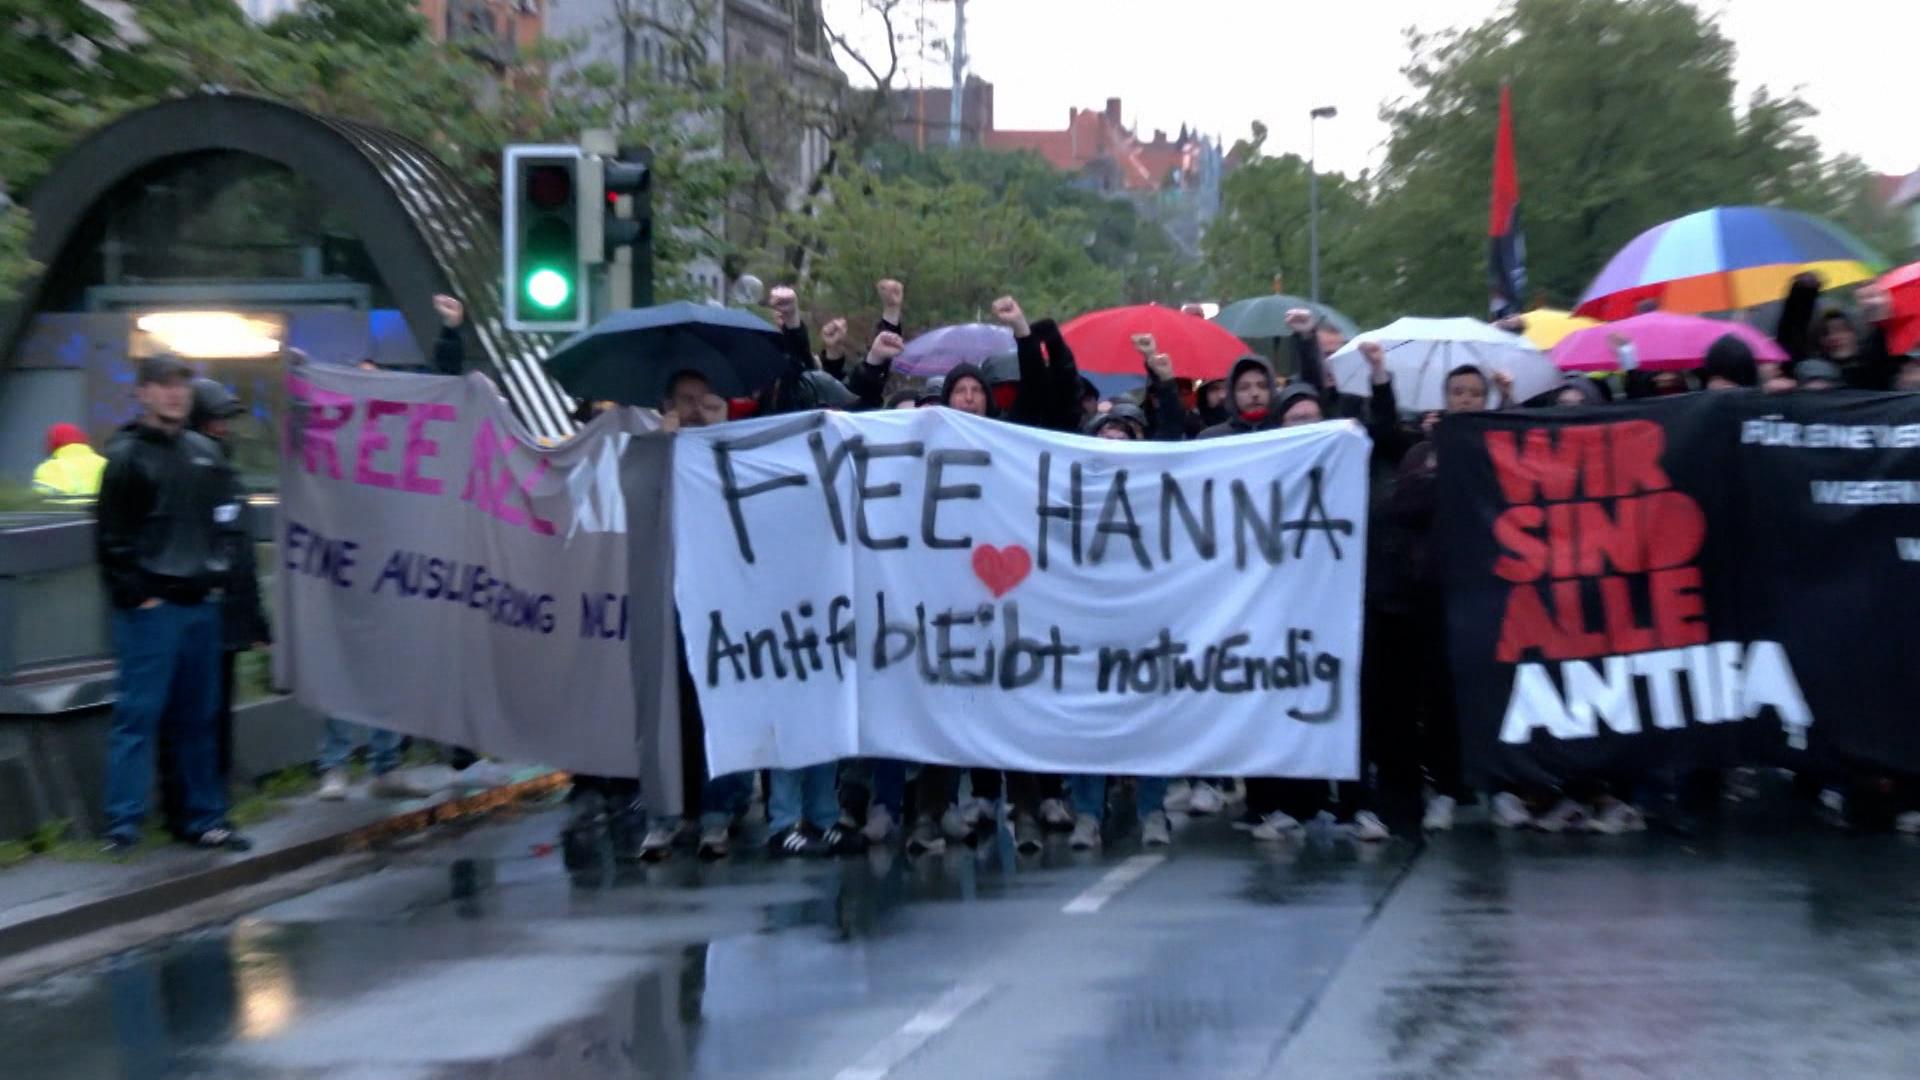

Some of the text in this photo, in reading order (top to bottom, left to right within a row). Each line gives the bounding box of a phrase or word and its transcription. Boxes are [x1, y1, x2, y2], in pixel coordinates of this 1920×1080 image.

[1484, 419, 1674, 503] WIR
[1036, 450, 1353, 571] HANNA
[1492, 490, 1708, 583] SIND
[1495, 566, 1710, 664] ALLE
[1498, 640, 1815, 751] ANTIFA
